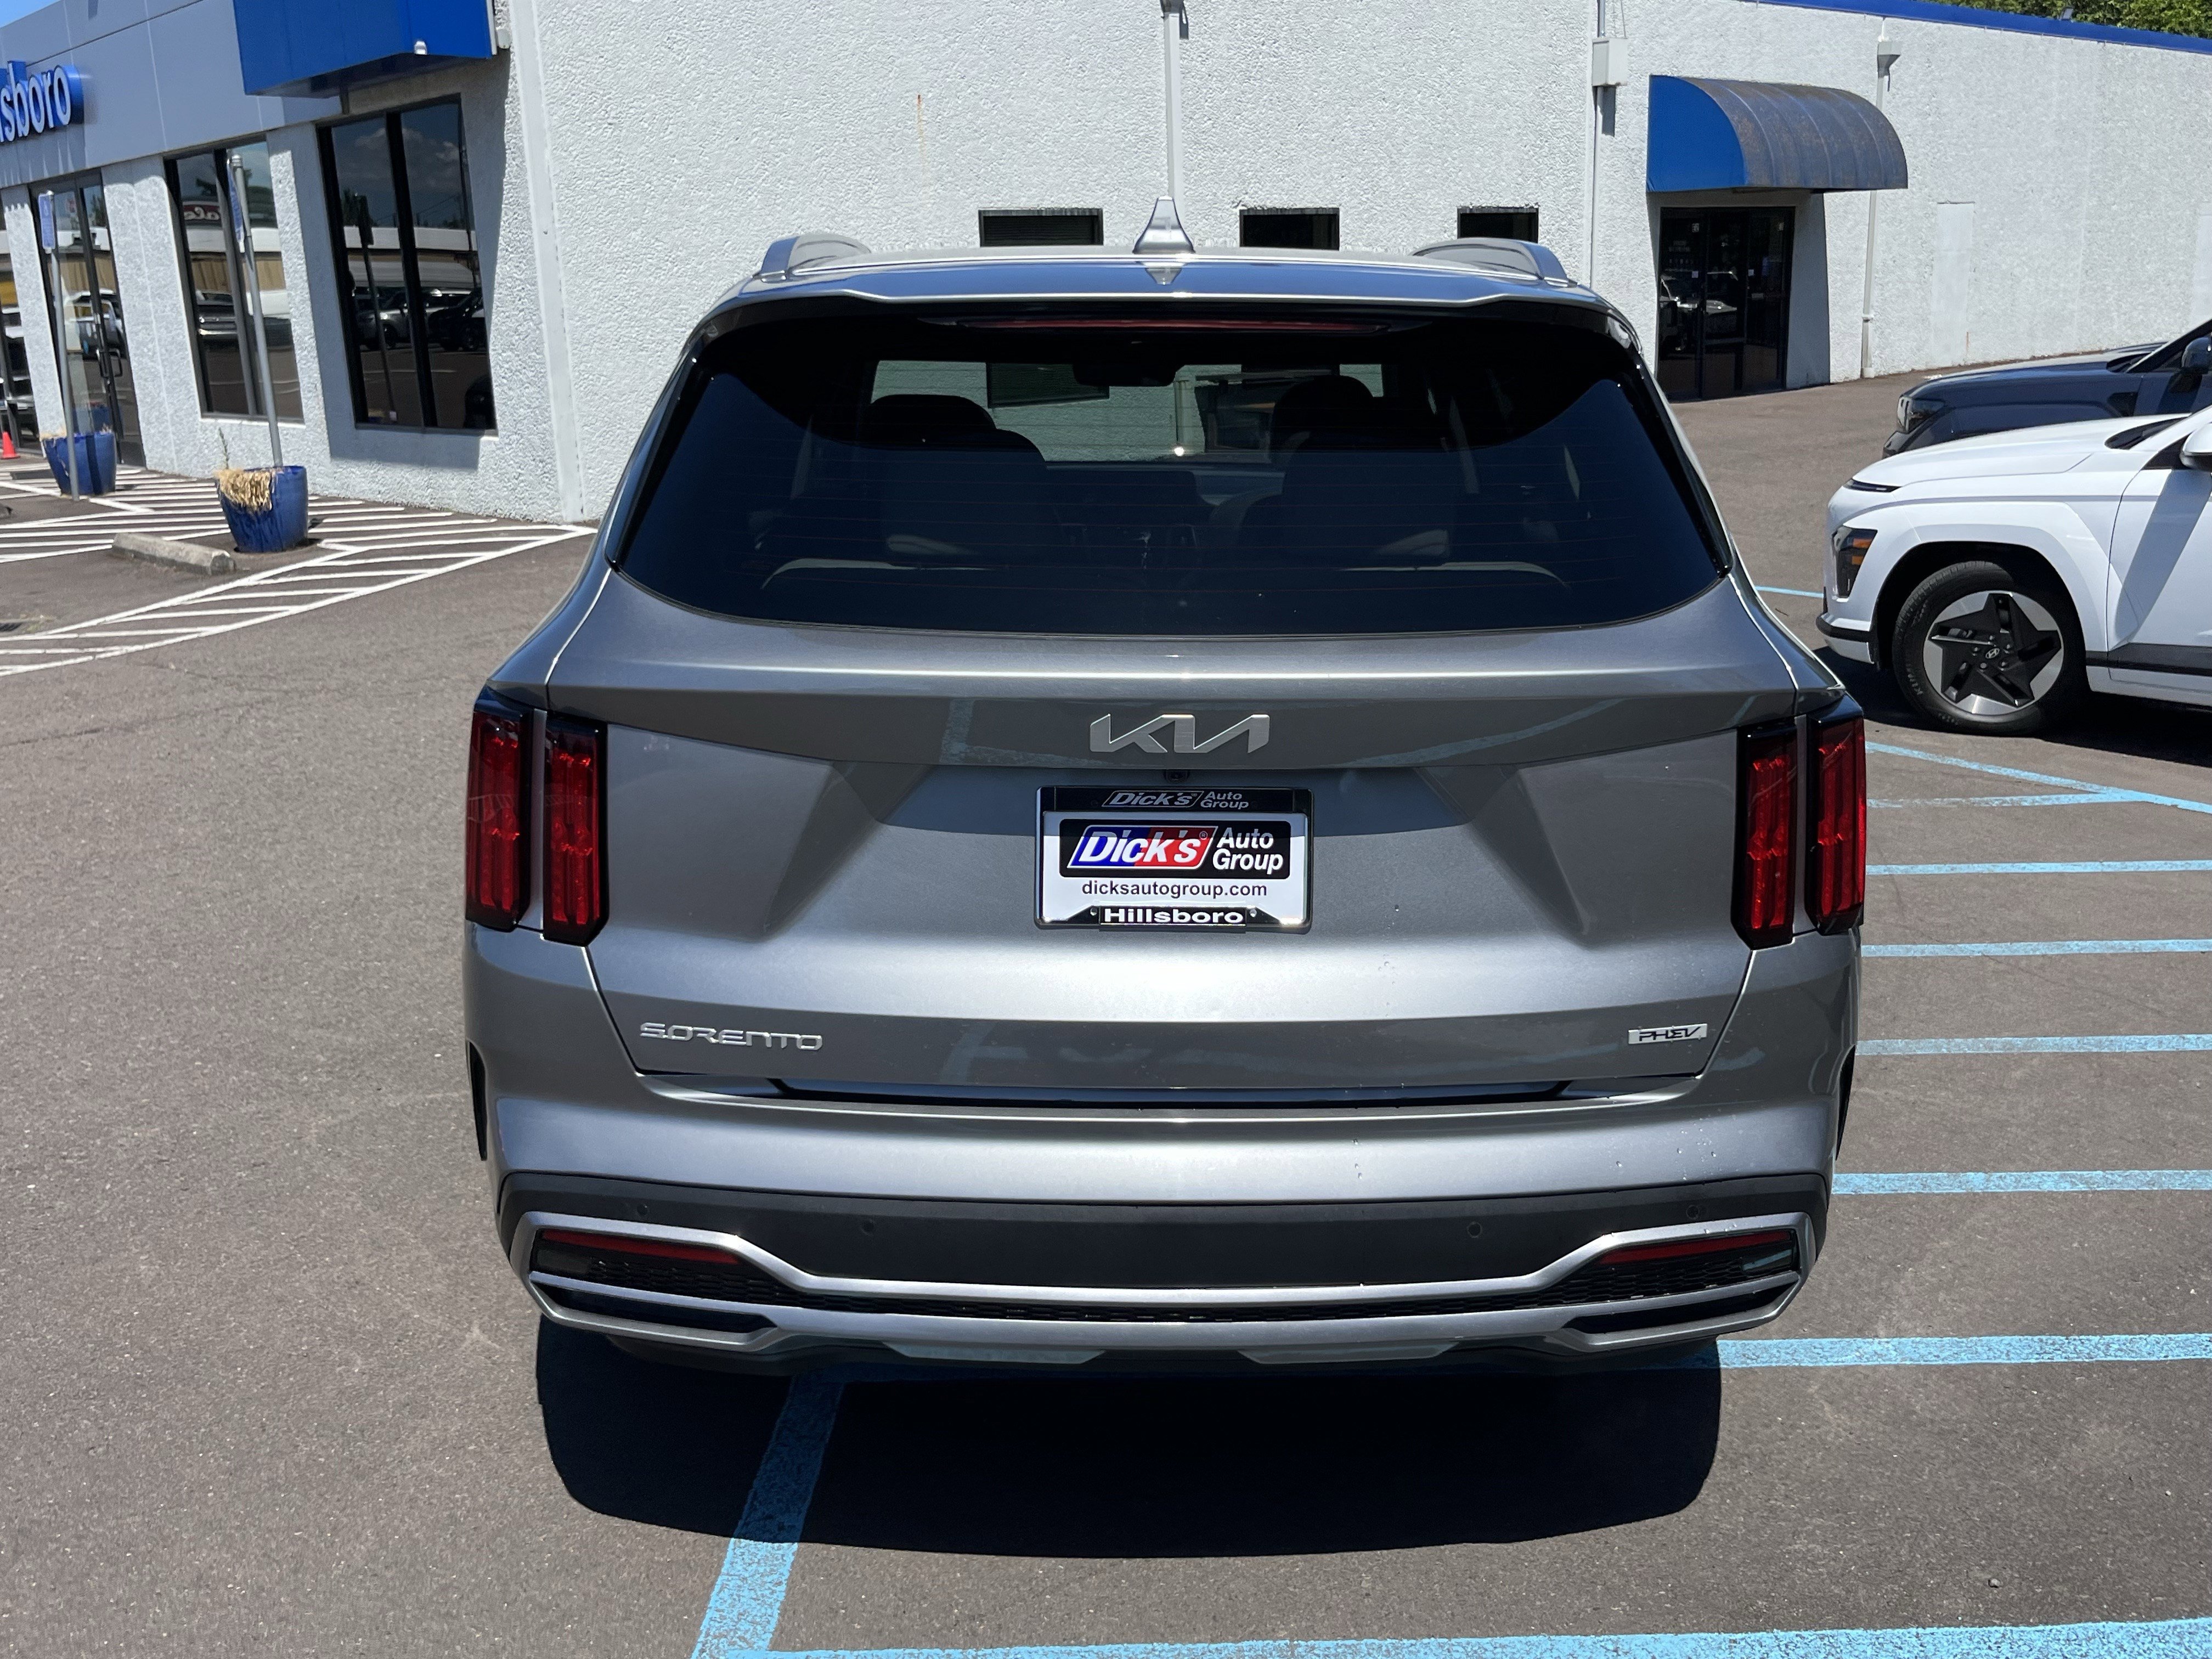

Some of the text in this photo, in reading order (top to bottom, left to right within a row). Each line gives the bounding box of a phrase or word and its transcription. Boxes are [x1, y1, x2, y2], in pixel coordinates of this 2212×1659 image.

[1090, 714, 1270, 753] KIA
[1109, 791, 1243, 805] Dick's Auto
[1200, 799, 1249, 810] Group
[1078, 827, 1274, 863] Dick's Auto
[1212, 849, 1284, 875] Group
[1081, 880, 1267, 899] dicksautogroup.com
[1104, 908, 1244, 923] Hillsboro
[639, 1022, 823, 1051] SORENTO
[1638, 1026, 1701, 1042] PHEV
